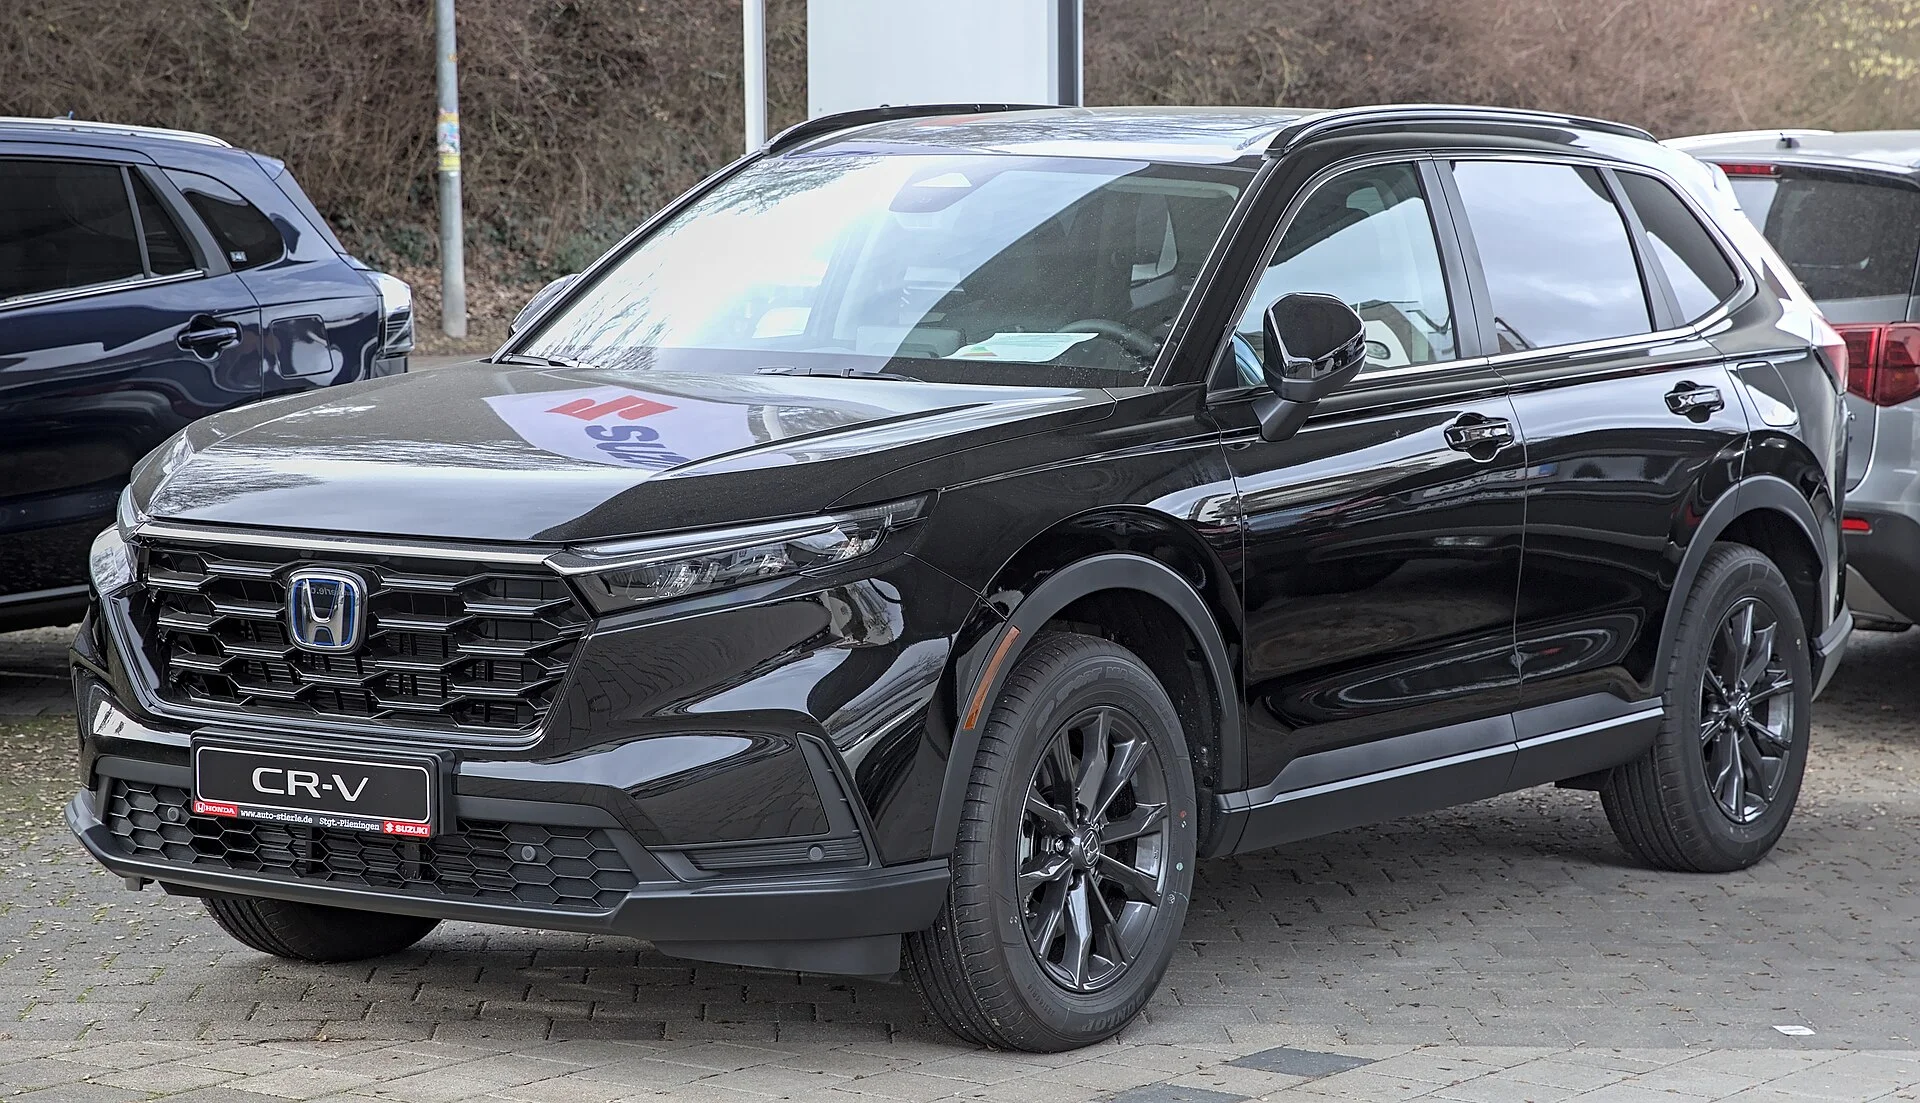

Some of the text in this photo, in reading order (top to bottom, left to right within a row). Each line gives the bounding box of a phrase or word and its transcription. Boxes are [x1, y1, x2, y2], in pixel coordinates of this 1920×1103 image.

[252, 767, 369, 802] CR-V
[205, 804, 236, 814] HONDA
[240, 810, 380, 831] www.auto-stierle.de Stgt.-Plieningen
[395, 824, 428, 834] SUZUKI
